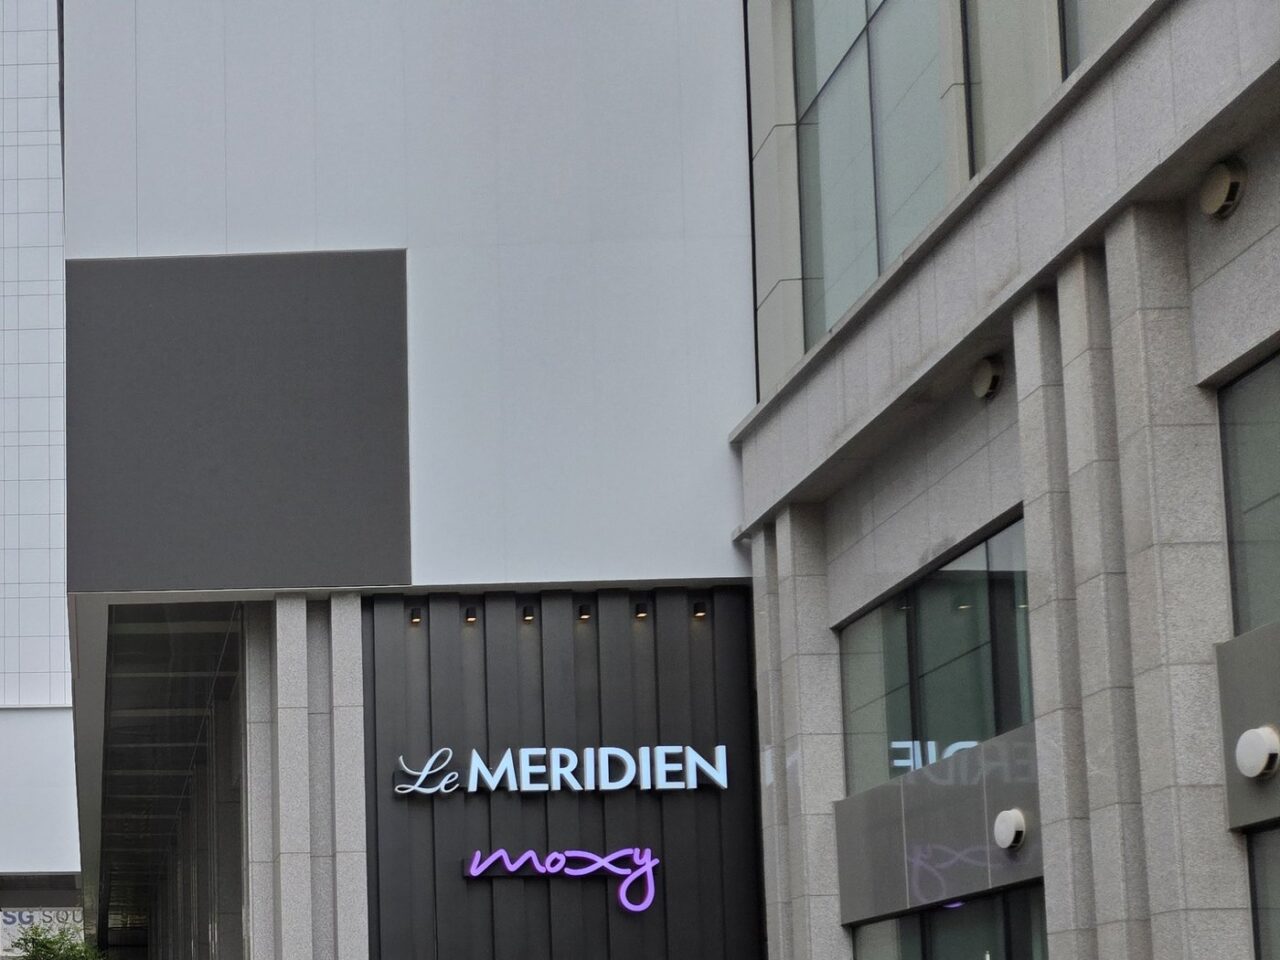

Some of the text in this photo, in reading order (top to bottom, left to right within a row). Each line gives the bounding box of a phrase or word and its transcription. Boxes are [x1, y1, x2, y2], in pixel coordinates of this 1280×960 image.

[394, 745, 728, 794] Le MERIDIEN
[469, 847, 659, 912] moxy
[2, 911, 34, 925] SG
